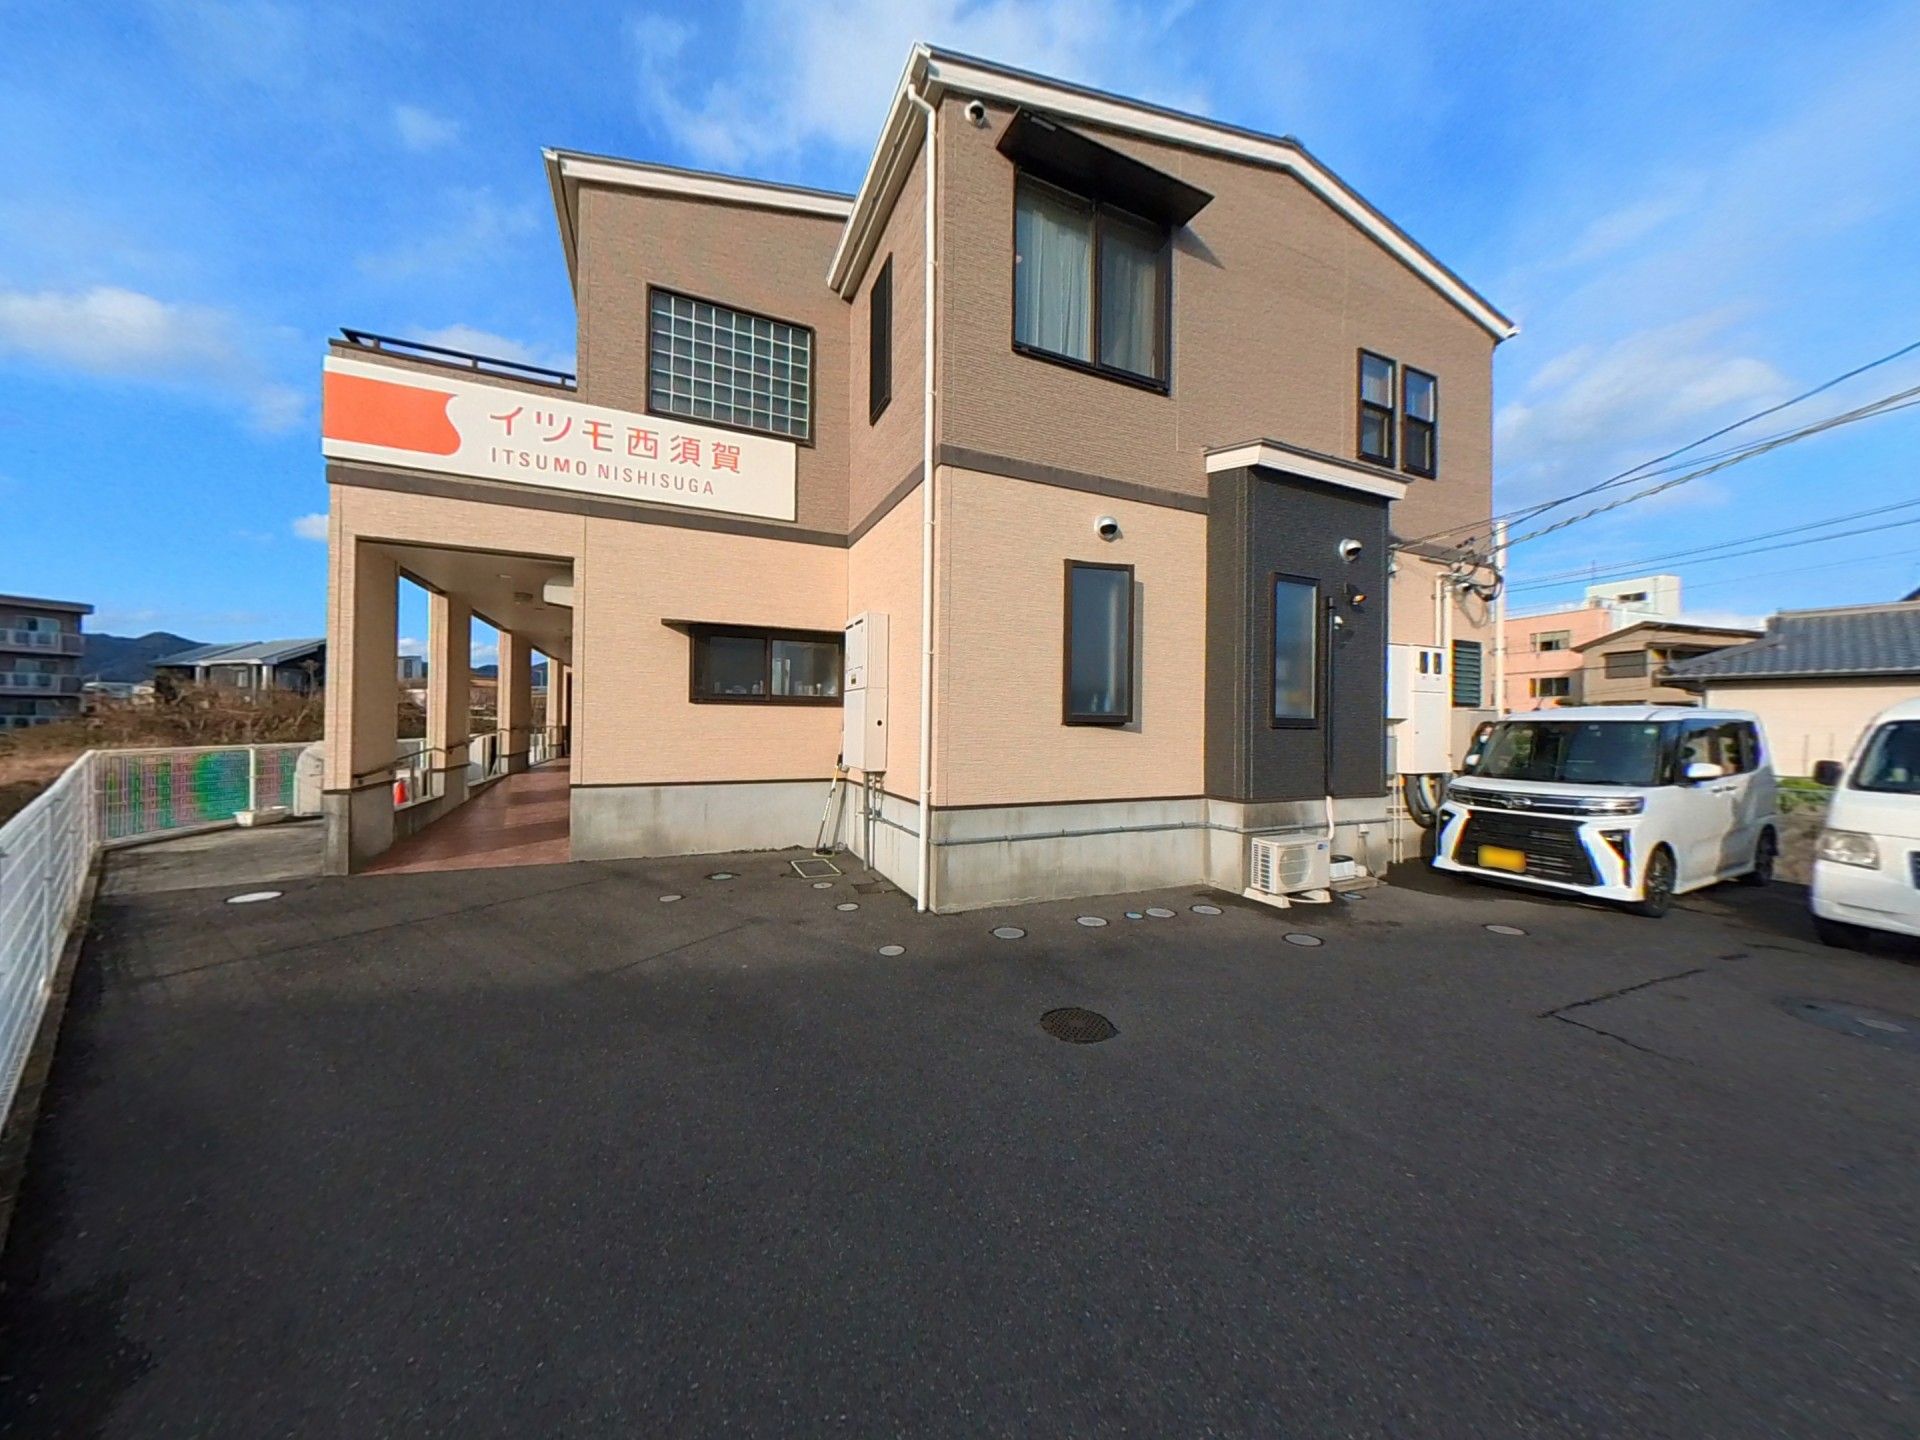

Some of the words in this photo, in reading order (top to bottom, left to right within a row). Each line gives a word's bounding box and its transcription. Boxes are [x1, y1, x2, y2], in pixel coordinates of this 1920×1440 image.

[490, 407, 741, 474] イツモ西須賀
[491, 447, 588, 476] ITSUMO
[598, 464, 714, 495] NISHISUGA
